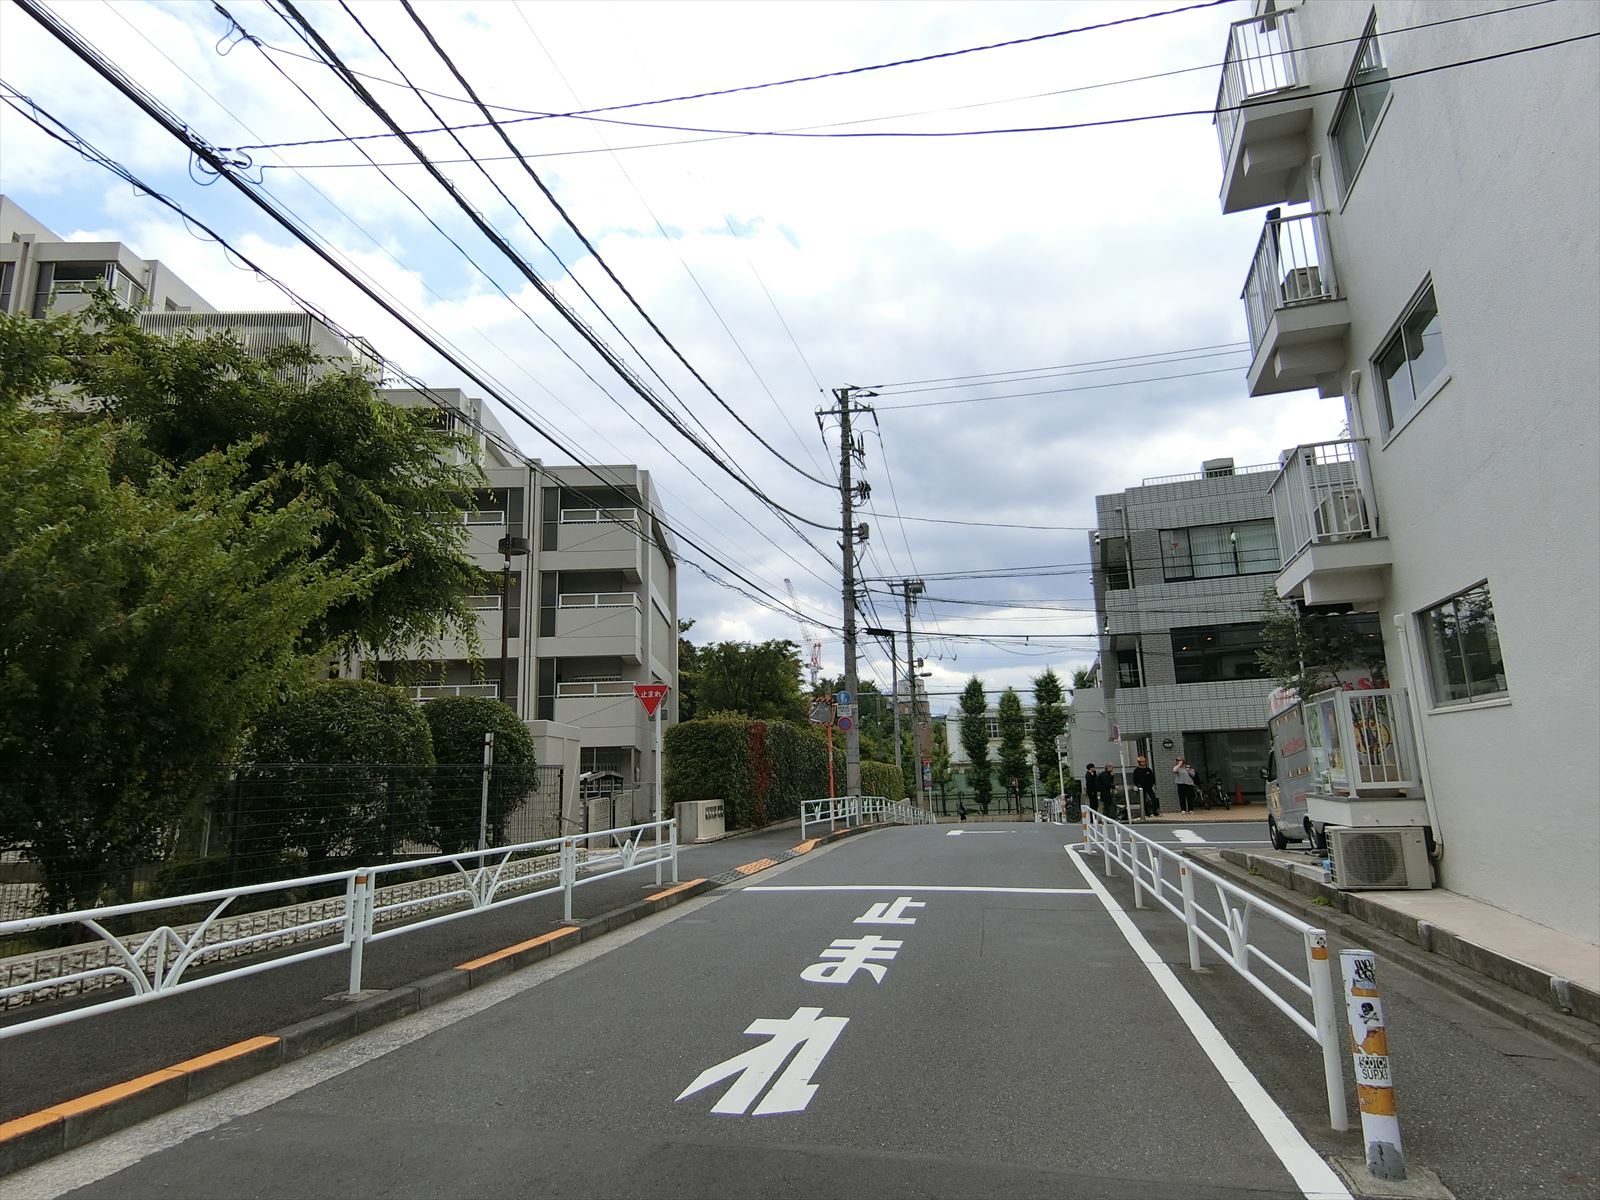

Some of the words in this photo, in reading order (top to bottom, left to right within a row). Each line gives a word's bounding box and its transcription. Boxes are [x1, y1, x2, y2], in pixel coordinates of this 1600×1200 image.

[640, 690, 662, 698] 止まれ
[674, 896, 927, 1117] 止まれ
[1358, 1056, 1388, 1069] SCOTCH
